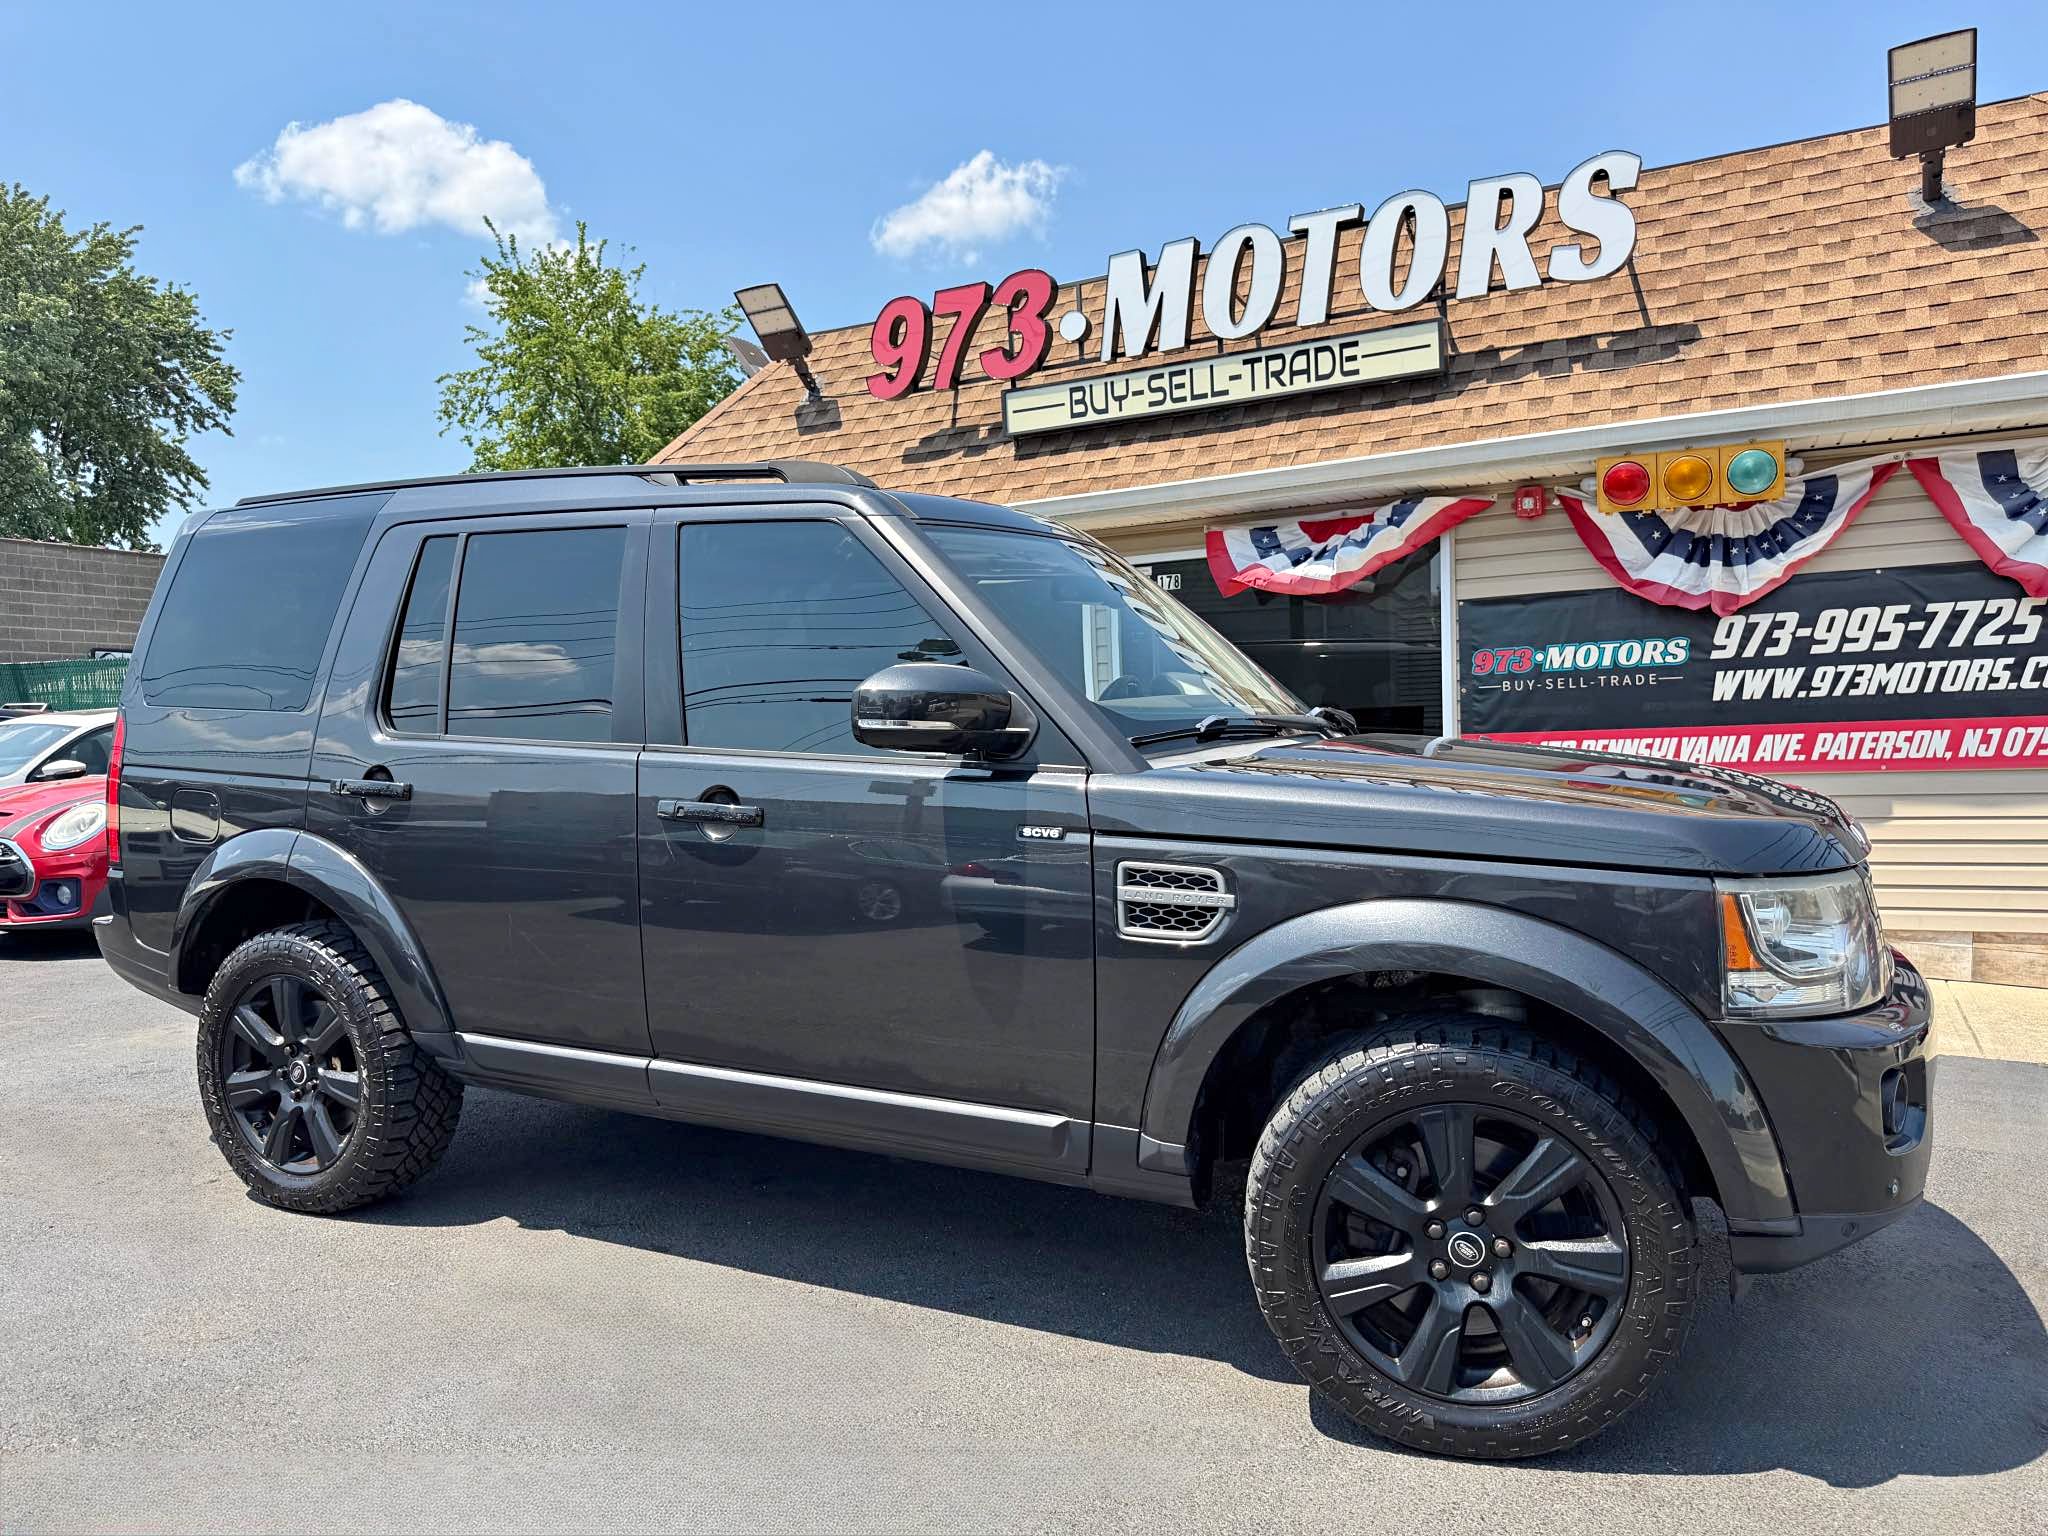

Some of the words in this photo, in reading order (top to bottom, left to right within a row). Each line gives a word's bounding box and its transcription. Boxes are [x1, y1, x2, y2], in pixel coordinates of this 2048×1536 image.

[866, 267, 1058, 401] 973
[1100, 149, 1643, 363] MOTORS
[1069, 340, 1360, 419] BUY-SELL-TRADE
[1159, 574, 1180, 589] 178
[1710, 596, 2048, 660] 973-995-7725
[1473, 647, 1534, 675] 973
[1542, 637, 1690, 672] MOTORS
[1502, 673, 1658, 692] BUY-SELL-TRADE
[1712, 655, 2048, 702] WWW.973MOTORS.C
[1753, 733, 1805, 763] AVE.
[1811, 729, 1953, 761] PATERSON,
[1958, 727, 2003, 758] NJ
[1022, 827, 1060, 839] SCV6
[1123, 890, 1164, 901] LAND
[1172, 893, 1226, 905] ROVER
